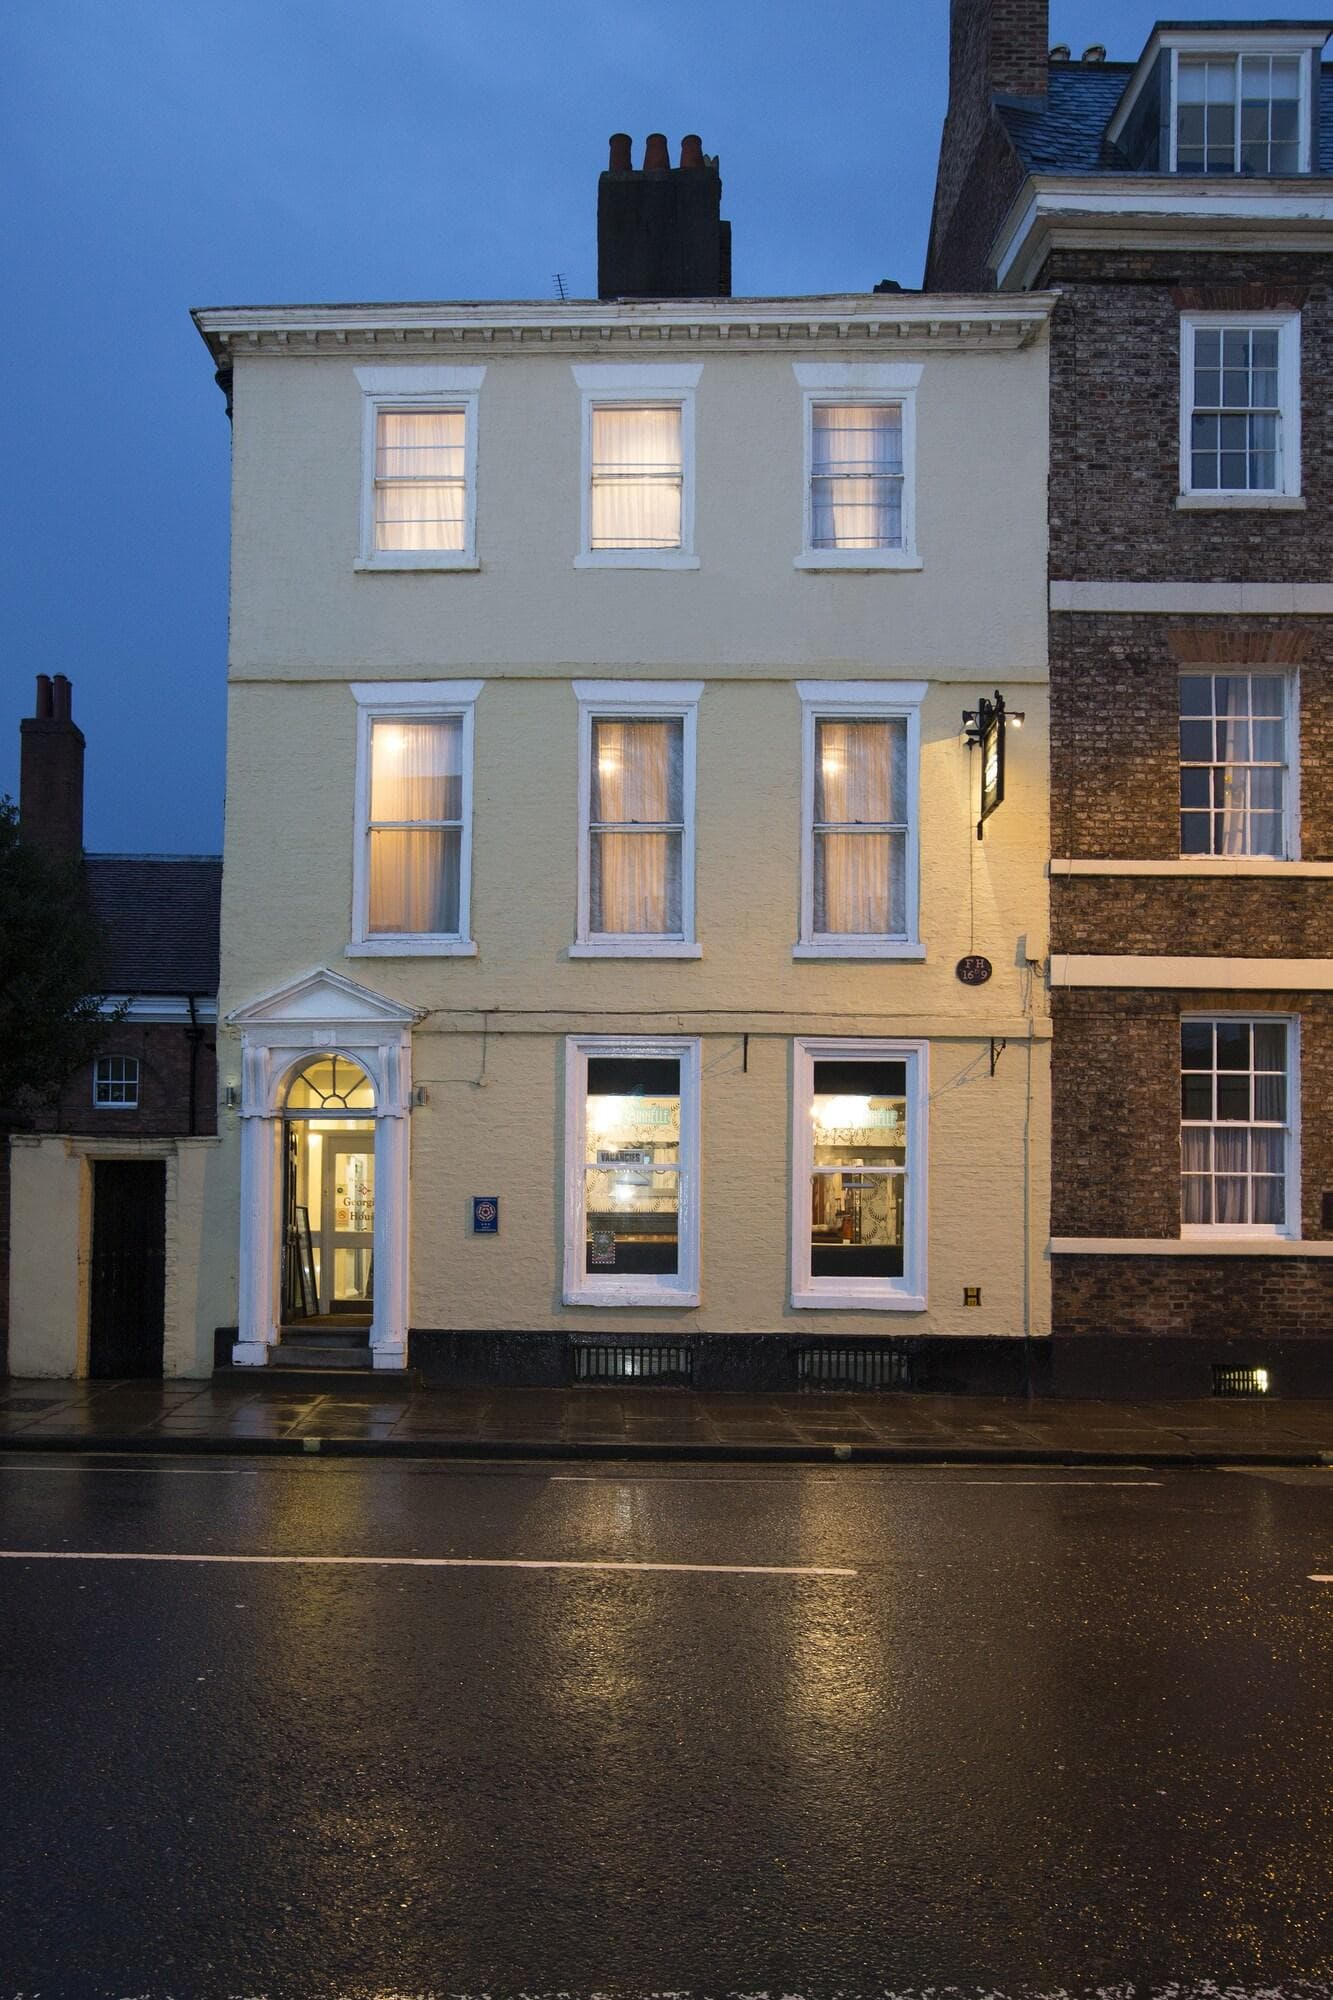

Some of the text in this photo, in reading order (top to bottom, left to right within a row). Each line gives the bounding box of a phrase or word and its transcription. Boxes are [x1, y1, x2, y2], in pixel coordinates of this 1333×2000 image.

[975, 959, 984, 969] H
[600, 1151, 641, 1162] VACANCIES
[963, 1287, 982, 1307] H
